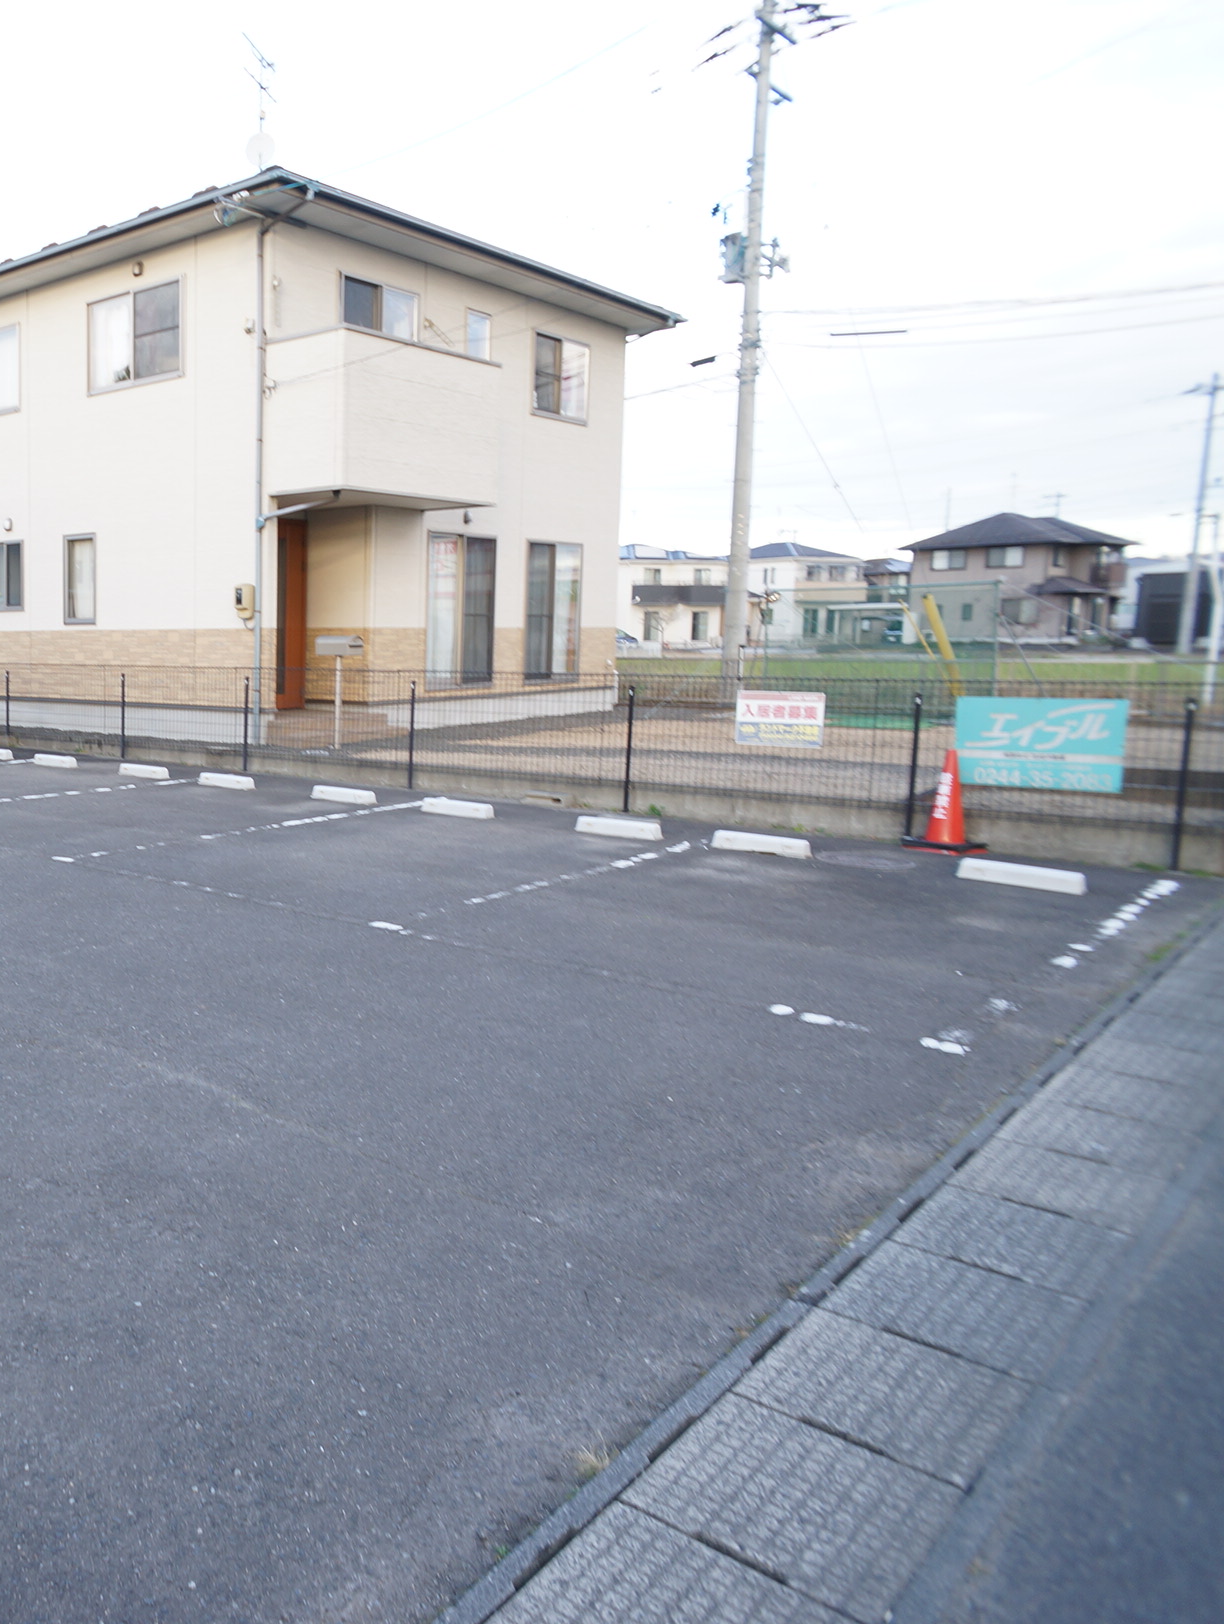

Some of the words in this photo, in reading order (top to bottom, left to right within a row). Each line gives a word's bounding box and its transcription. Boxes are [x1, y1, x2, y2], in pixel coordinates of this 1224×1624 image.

[741, 703, 818, 720] 入居者募集
[964, 702, 1117, 750] エイブル
